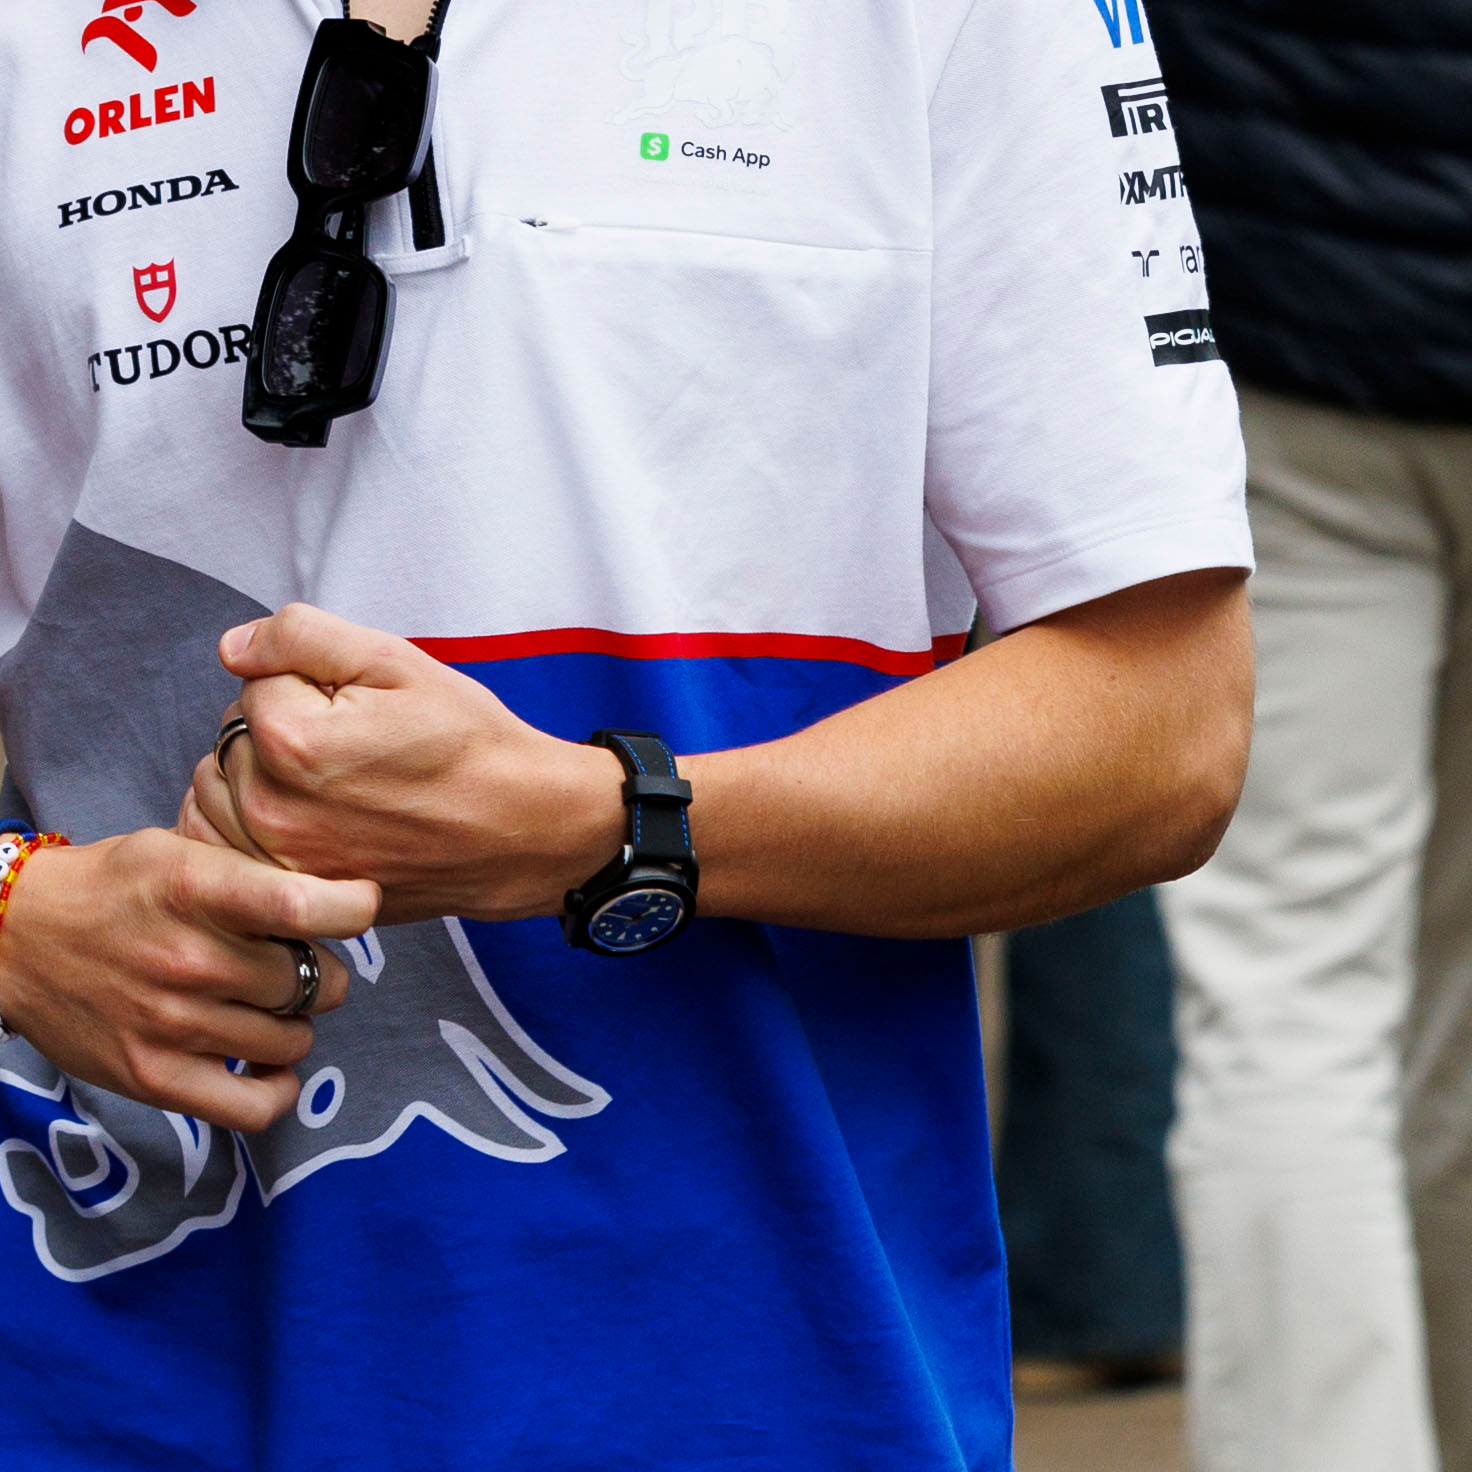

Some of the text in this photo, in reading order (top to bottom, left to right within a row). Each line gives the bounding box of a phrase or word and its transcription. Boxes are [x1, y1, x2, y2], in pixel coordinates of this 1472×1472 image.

[64, 76, 216, 146] ORLEN
[681, 141, 727, 161] Cash
[732, 147, 771, 169] App
[57, 168, 239, 229] HONDA
[88, 323, 251, 394] TUDOR
